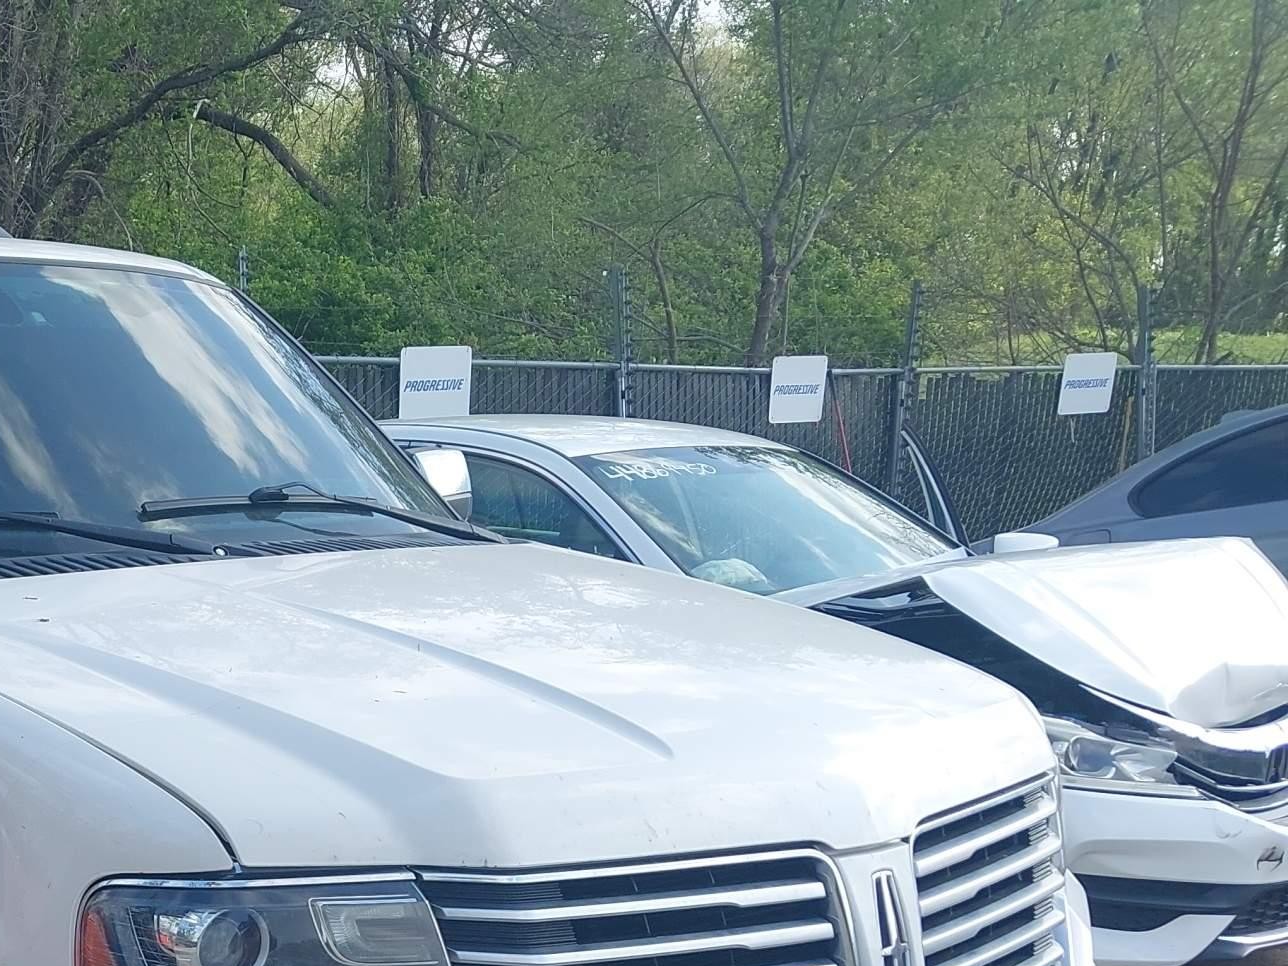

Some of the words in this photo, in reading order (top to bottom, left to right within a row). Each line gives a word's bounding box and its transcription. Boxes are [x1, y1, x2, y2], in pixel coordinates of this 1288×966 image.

[404, 379, 464, 392] PROGRESSIVE
[773, 384, 820, 395] PROGRESSIVE
[1064, 378, 1110, 390] PROGRESSIVE
